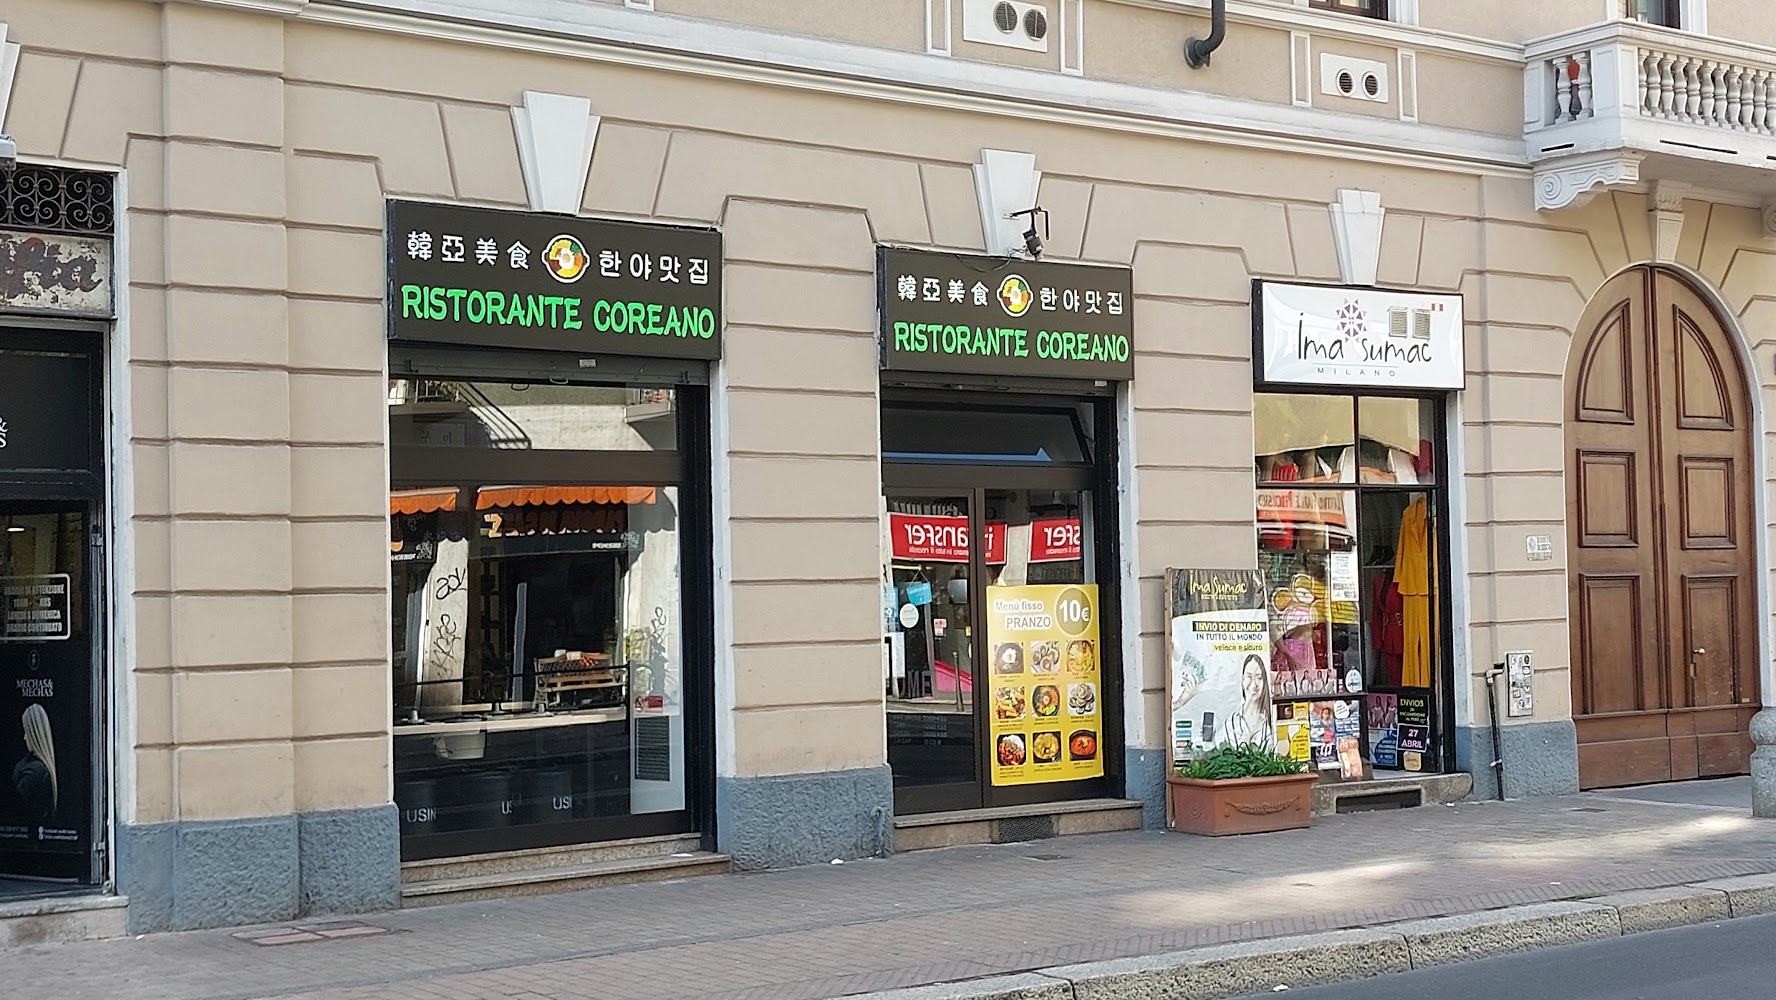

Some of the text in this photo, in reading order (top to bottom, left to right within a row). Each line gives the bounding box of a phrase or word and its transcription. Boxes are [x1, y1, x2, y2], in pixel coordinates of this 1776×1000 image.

[407, 230, 531, 270] 韓亞美食
[599, 249, 709, 284] 한야맛집
[897, 274, 990, 307] 韓亞美食
[1039, 287, 1123, 315] 한야맛집
[401, 285, 715, 339] RISTORANTE COREANO
[893, 322, 1129, 362] RISTORANTE COREANO
[1317, 367, 1396, 377] MILANO
[1021, 600, 1043, 611] fisso
[1059, 599, 1089, 623] 10€
[1006, 616, 1051, 629] PRANZO
[1195, 622, 1262, 632] INVIO DI DENARO
[21, 687, 54, 697] MECHAS
[1408, 729, 1419, 737] 27
[1401, 739, 1423, 748] ABRIL
